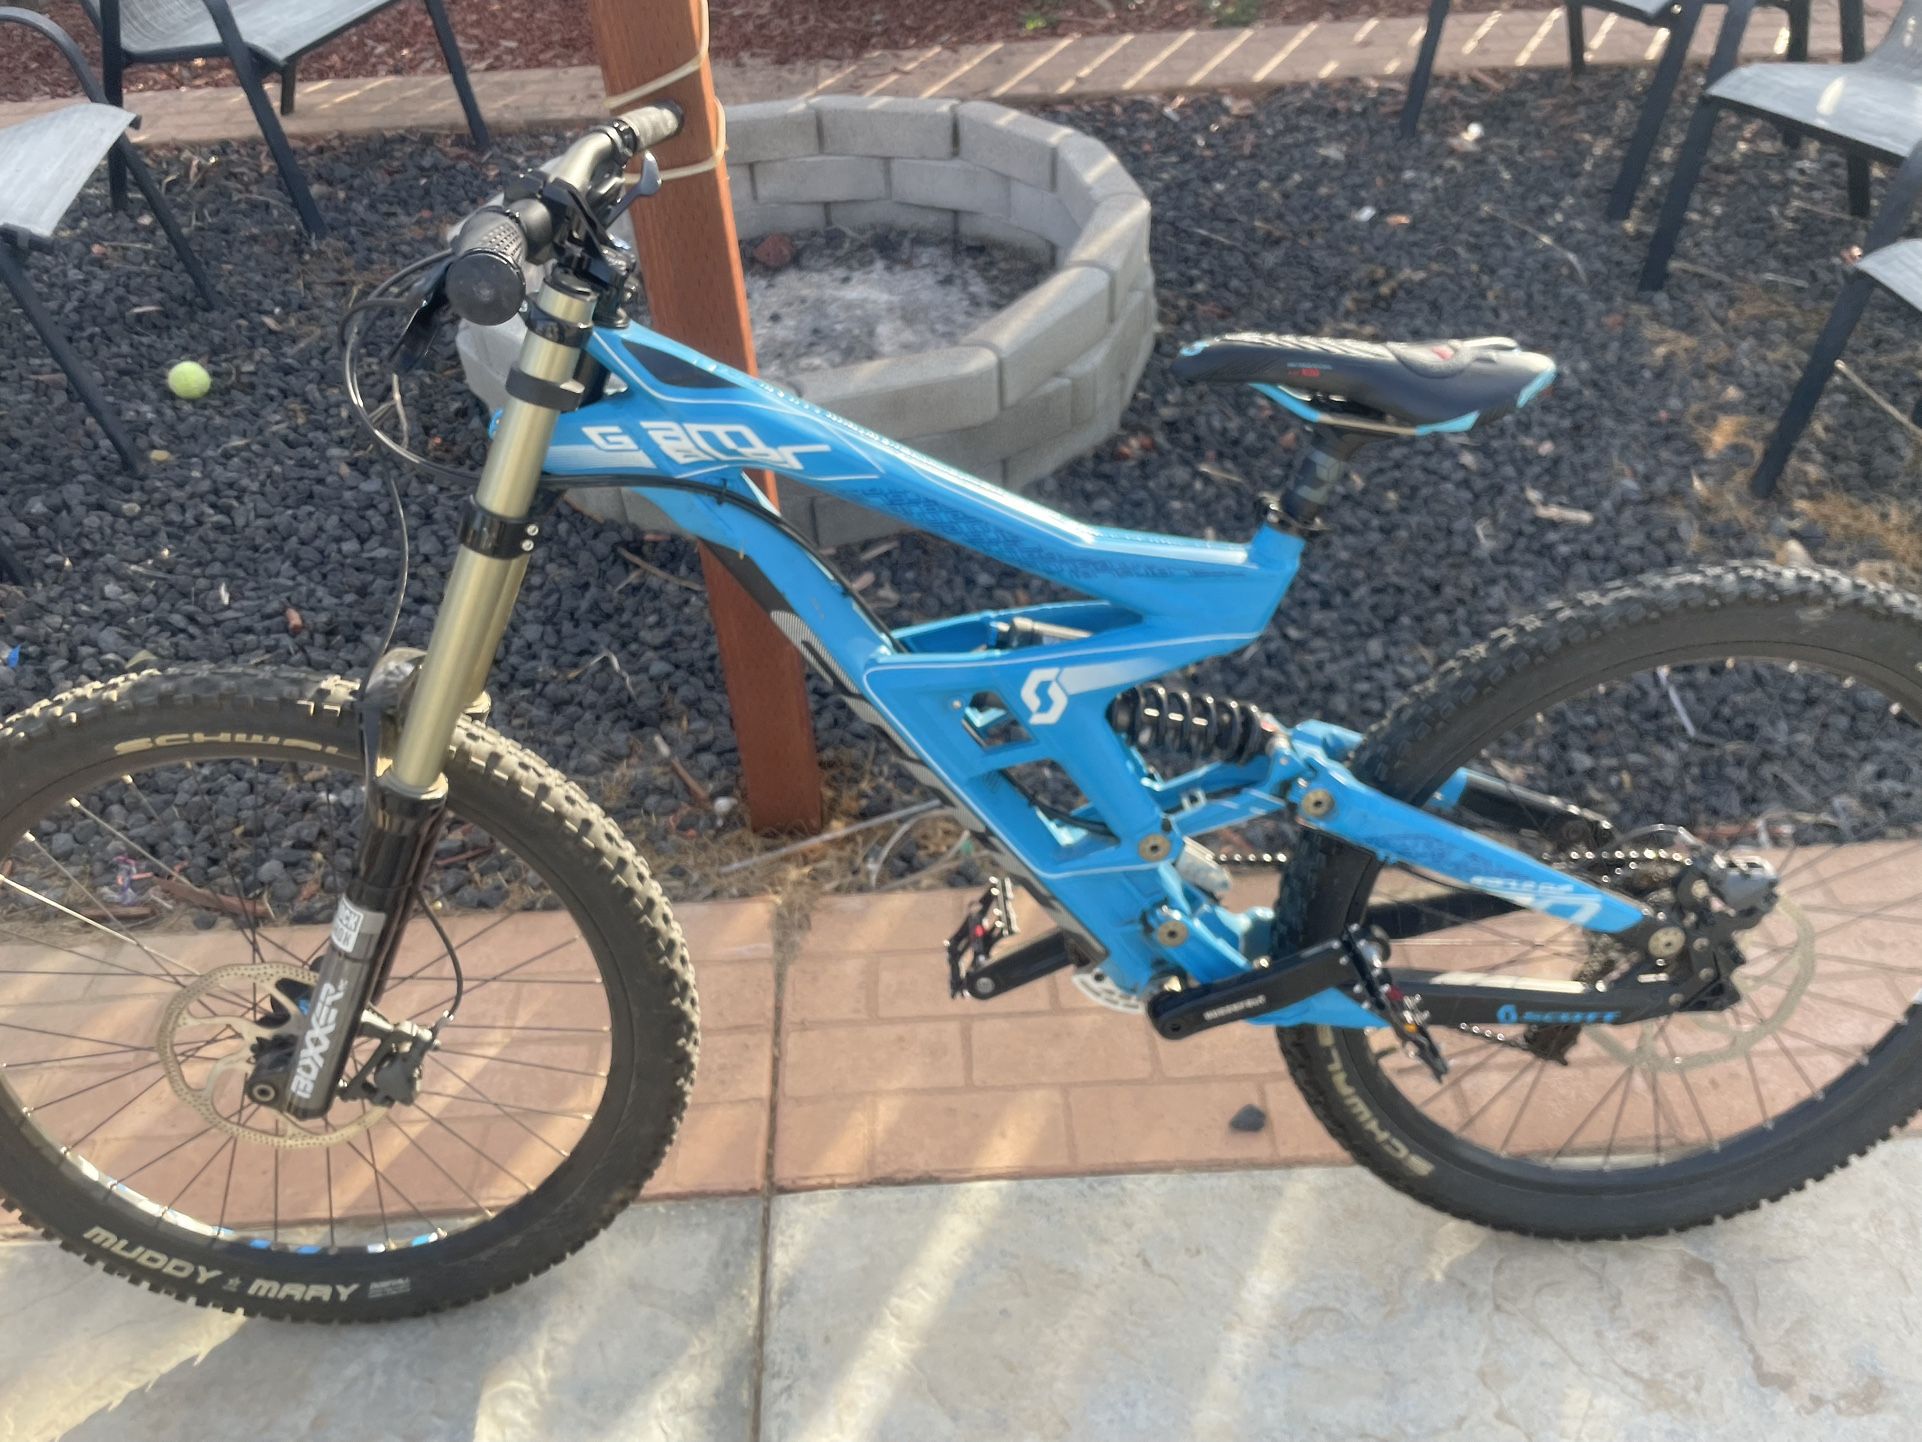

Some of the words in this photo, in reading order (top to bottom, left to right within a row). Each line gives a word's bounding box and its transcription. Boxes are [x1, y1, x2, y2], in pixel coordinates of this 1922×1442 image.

[291, 982, 344, 1099] BOXXER
[83, 1226, 222, 1283] MUDDY
[248, 1278, 360, 1302] MARY
